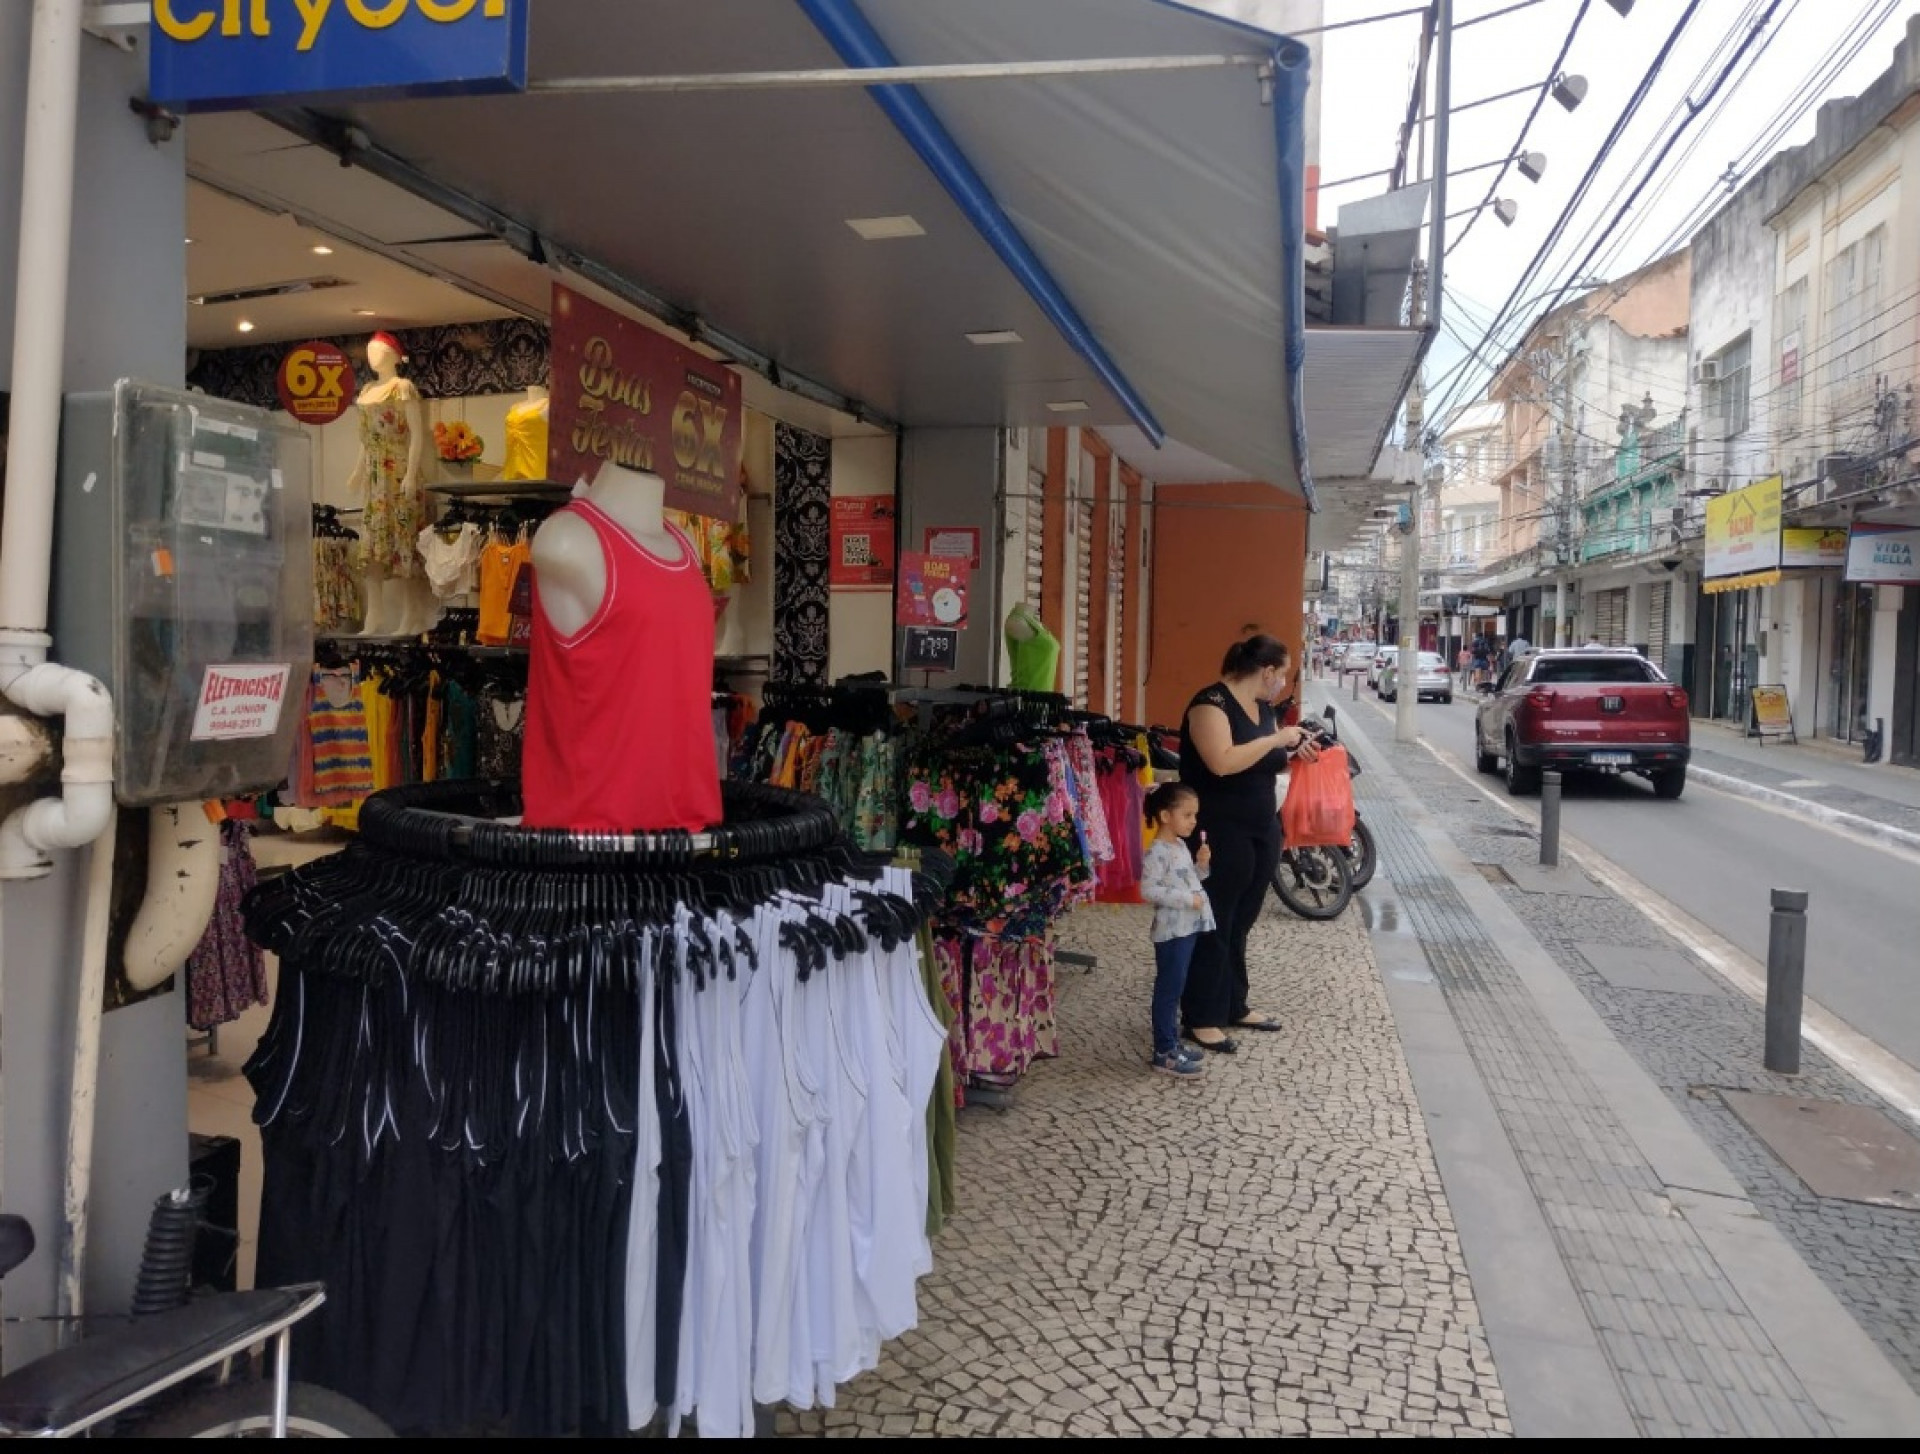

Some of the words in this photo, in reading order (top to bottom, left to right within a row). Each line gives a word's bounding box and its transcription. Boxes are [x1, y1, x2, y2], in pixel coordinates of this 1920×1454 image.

[579, 335, 650, 415] Boas
[671, 390, 727, 478] 6X
[1873, 553, 1912, 565] BELLA
[1875, 542, 1911, 554] VIDA
[203, 671, 284, 706] ELETRICISTA
